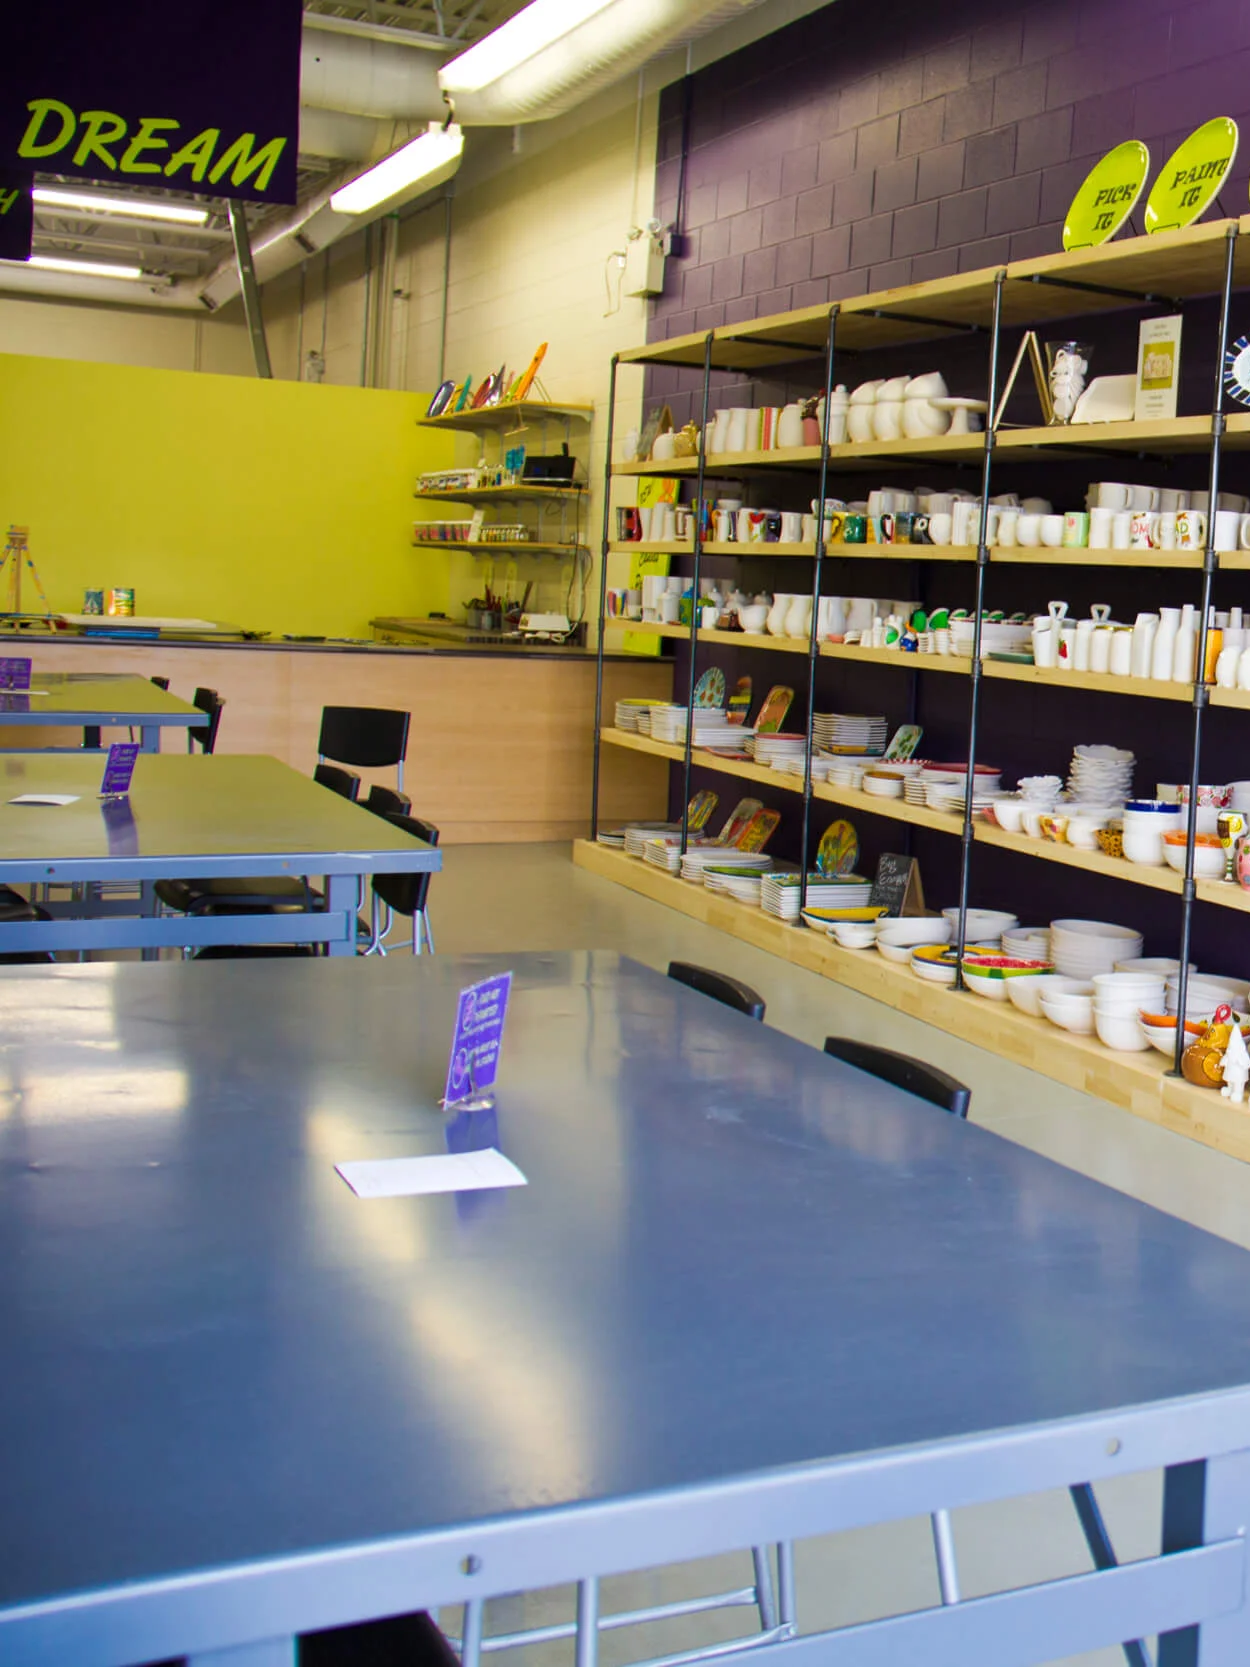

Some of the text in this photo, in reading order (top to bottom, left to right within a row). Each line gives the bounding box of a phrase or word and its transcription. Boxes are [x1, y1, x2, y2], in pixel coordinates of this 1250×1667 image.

[17, 98, 288, 192] DREAM
[1169, 157, 1231, 190] PAINT
[1092, 183, 1137, 208] PICK
[1177, 186, 1202, 208] IT
[1091, 211, 1116, 231] IT
